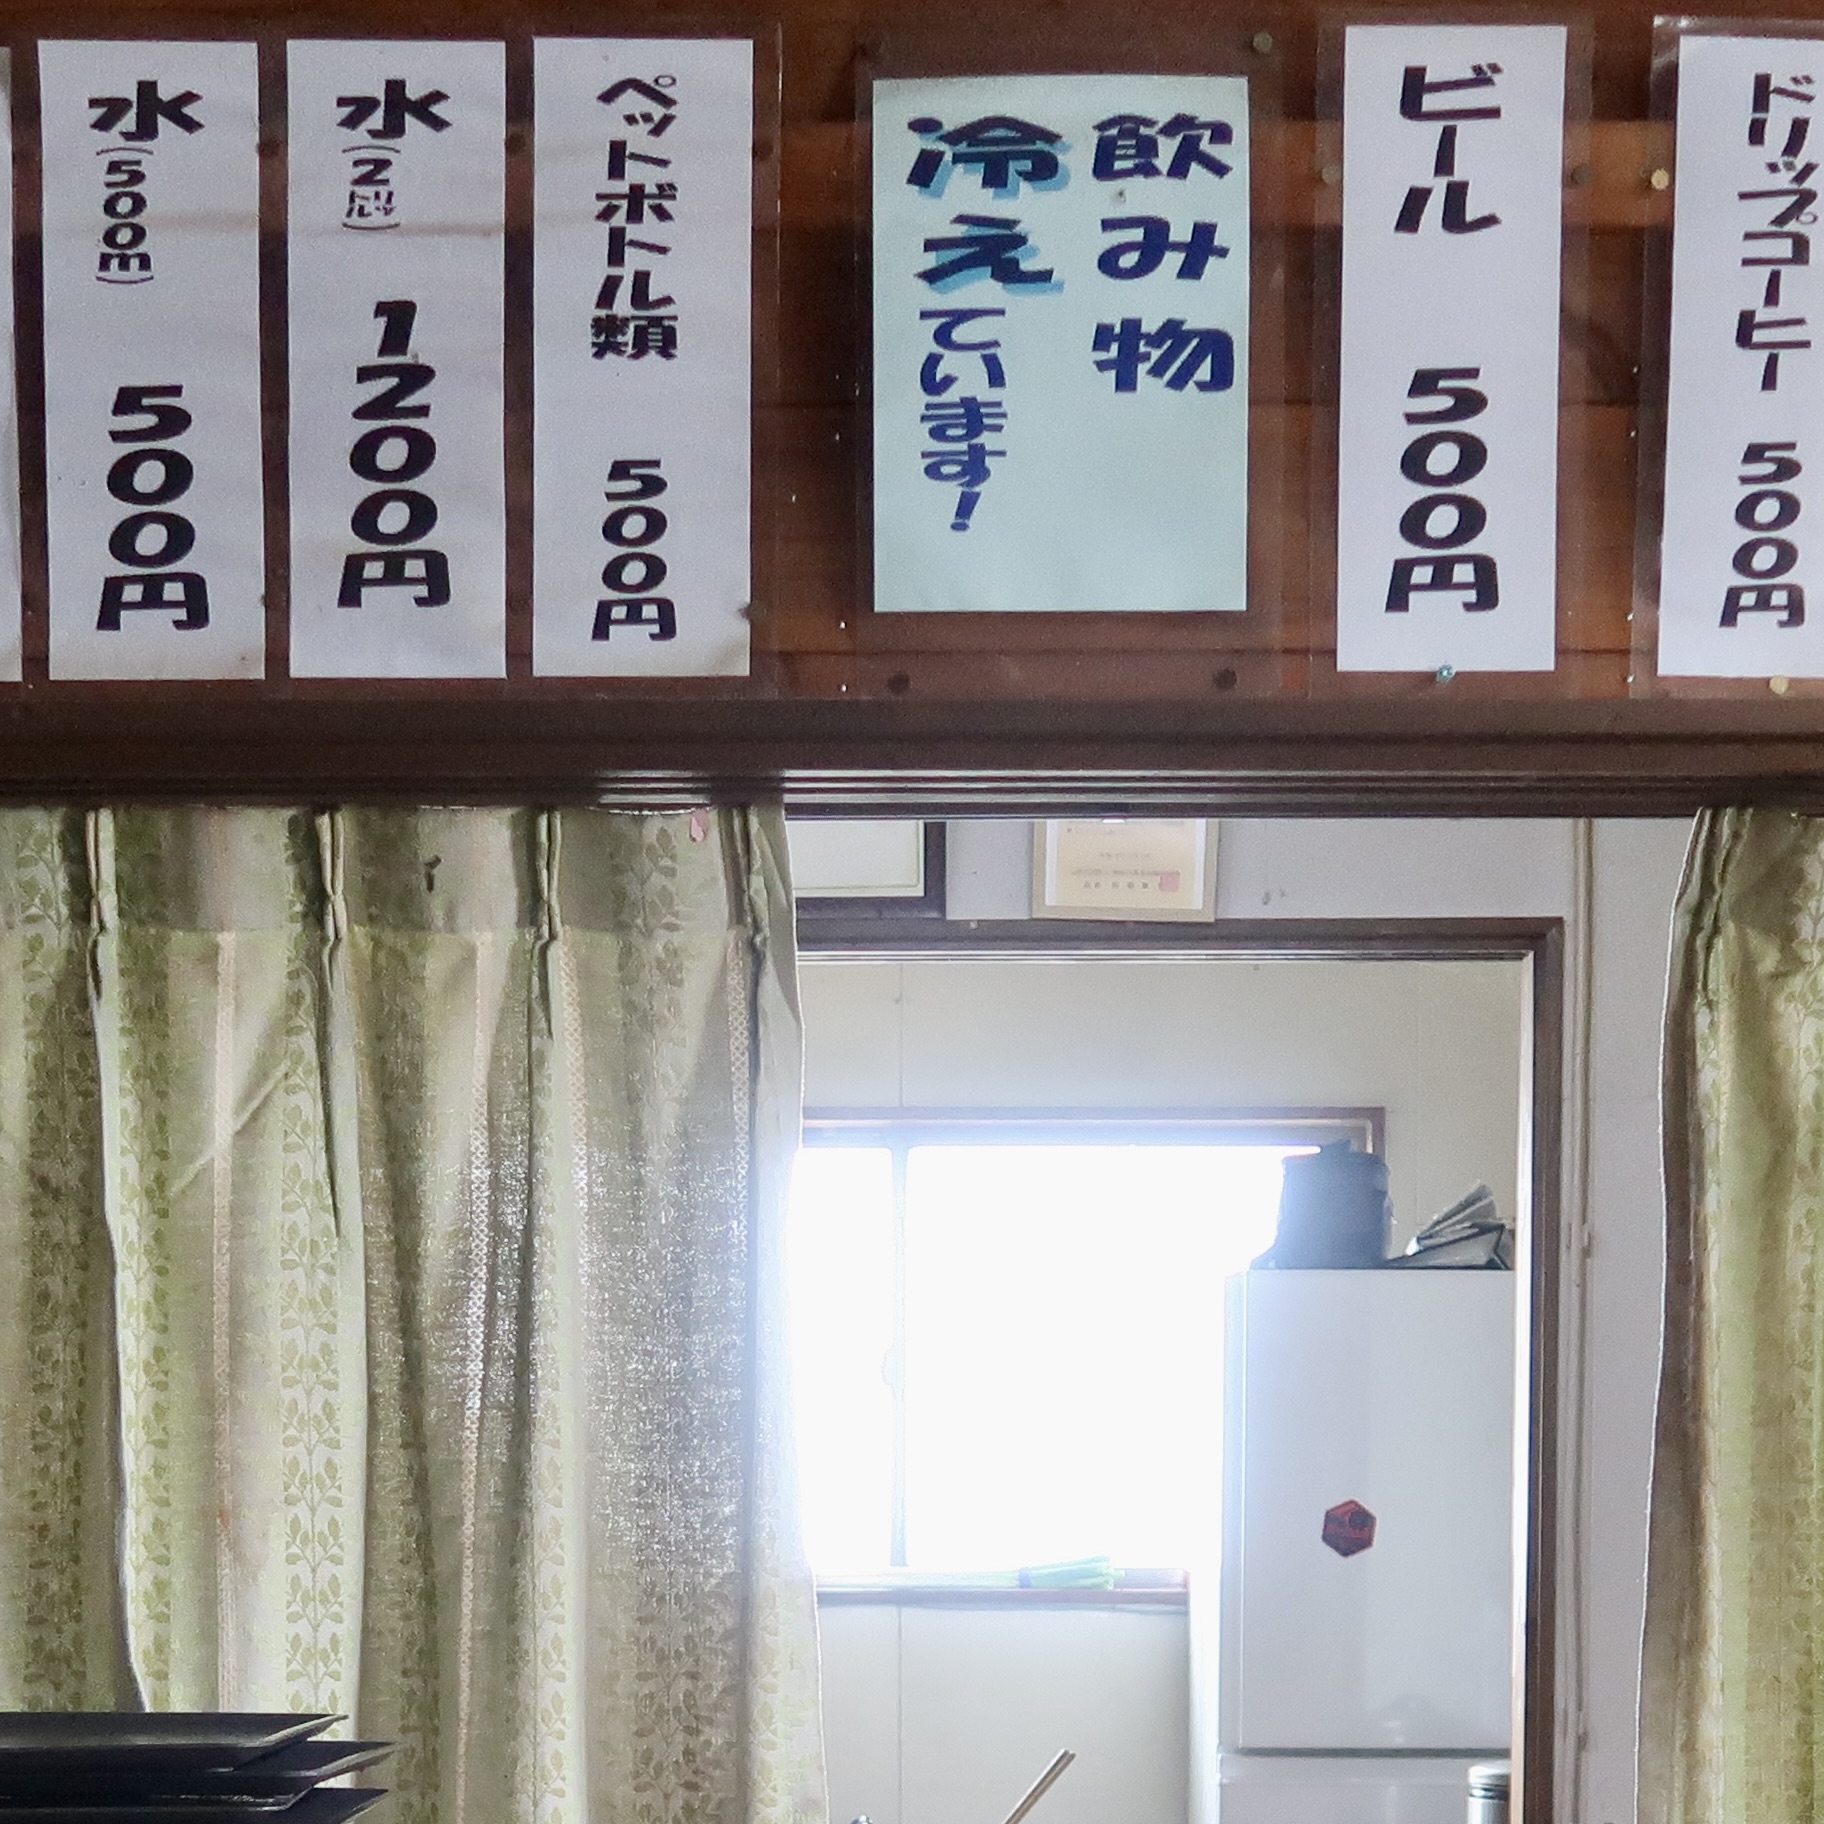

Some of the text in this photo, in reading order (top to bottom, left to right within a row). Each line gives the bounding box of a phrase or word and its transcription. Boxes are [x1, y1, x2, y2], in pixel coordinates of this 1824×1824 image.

[590, 76, 680, 360] ペットボトル類
[1090, 113, 1237, 395] 飲み物
[1394, 63, 1502, 236] ビール
[1735, 72, 1819, 395] ドリップコーヒー
[97, 384, 210, 634] 500円
[338, 301, 452, 609] 1200円
[591, 459, 678, 643] 500円
[1384, 368, 1501, 614] 500円
[1719, 442, 1807, 630] 500円
